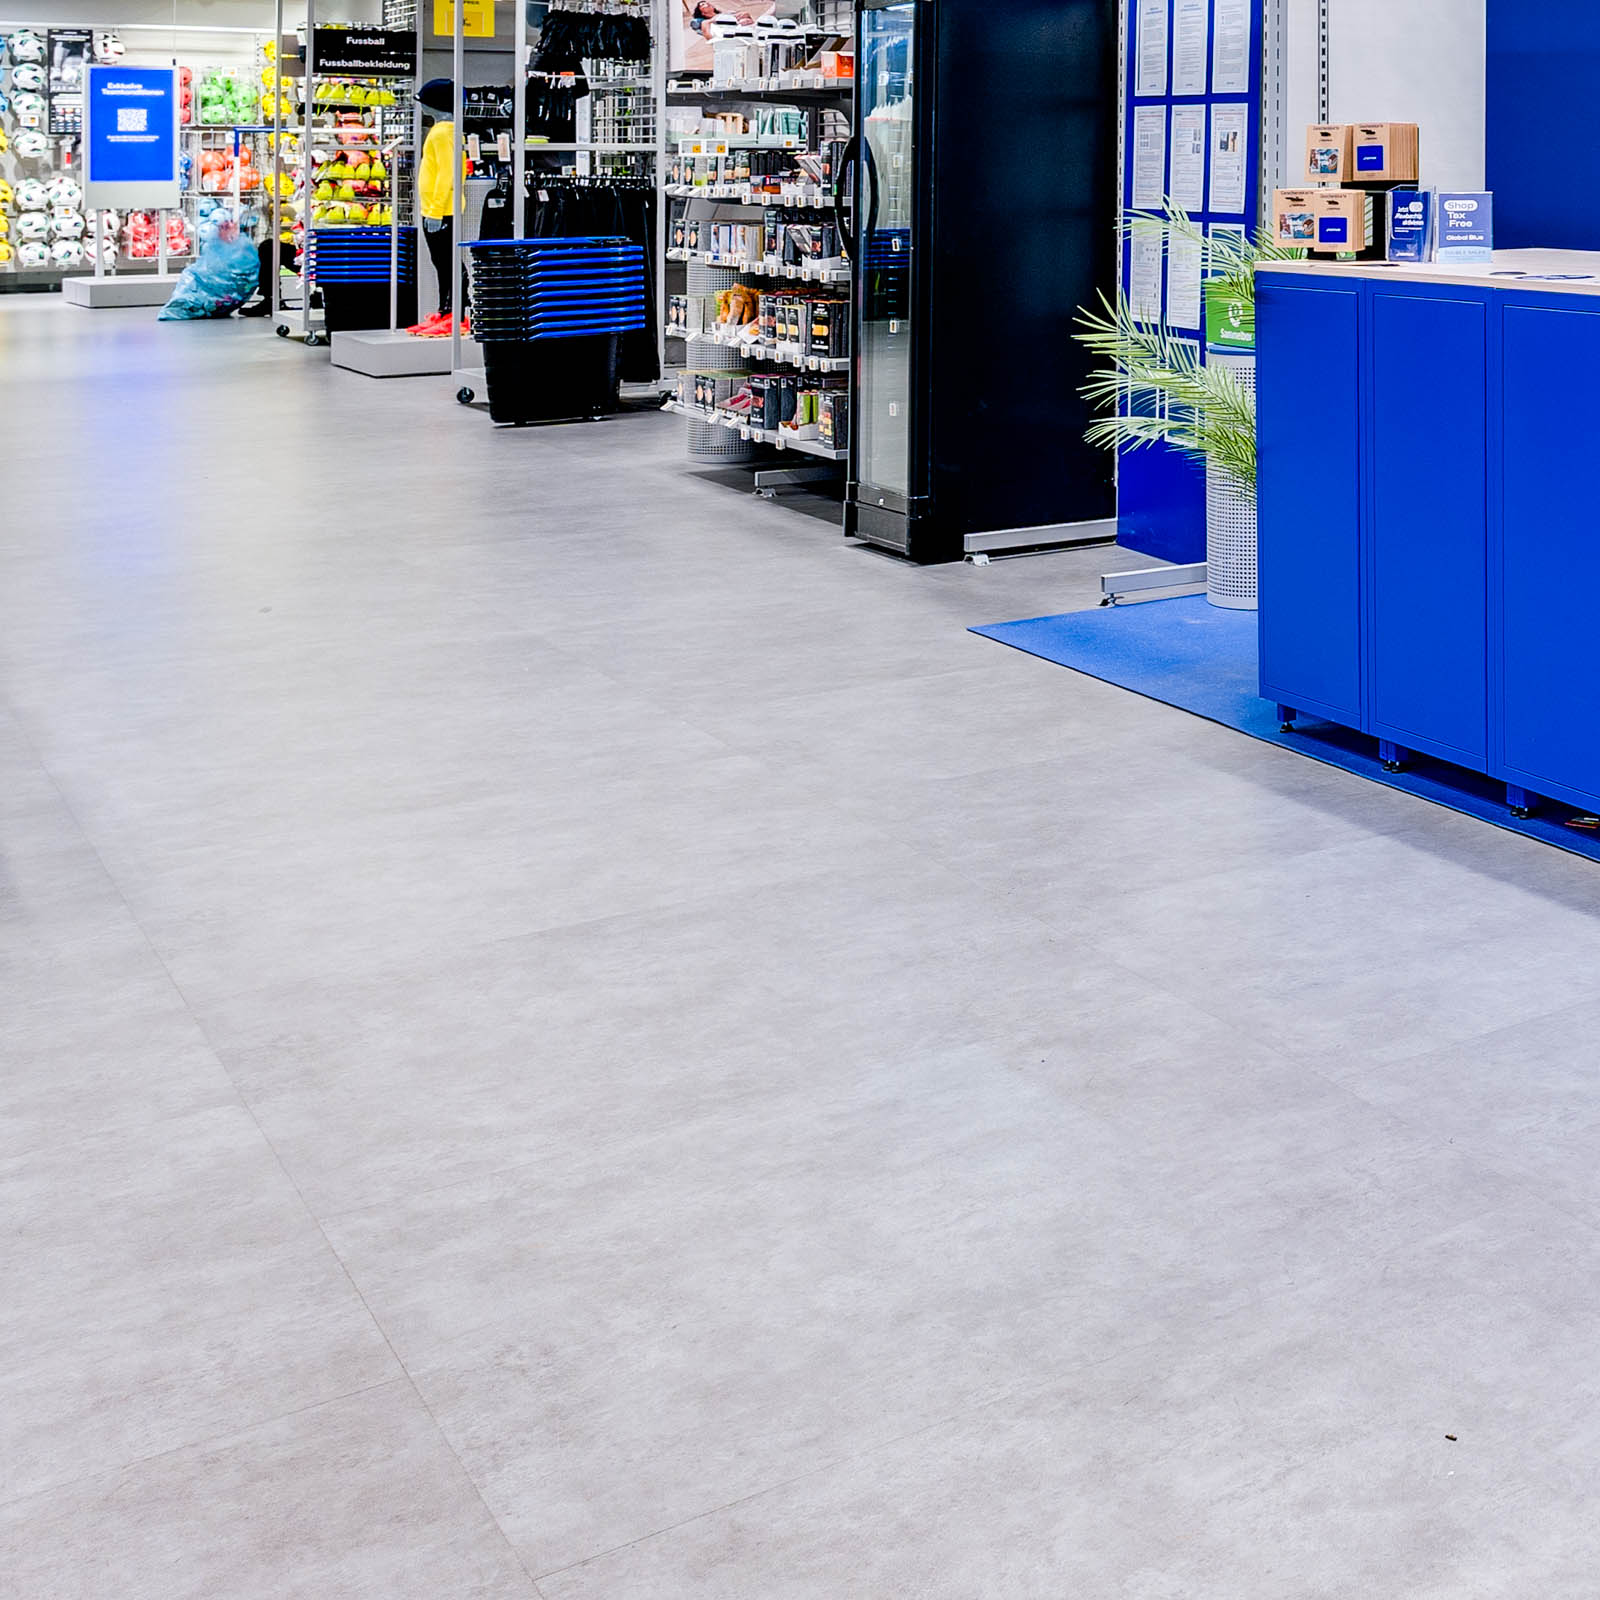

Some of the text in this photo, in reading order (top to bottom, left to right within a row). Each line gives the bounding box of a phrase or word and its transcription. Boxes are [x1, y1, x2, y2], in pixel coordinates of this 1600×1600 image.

[346, 36, 385, 45] Fussball
[319, 58, 410, 70] Fussballbekleidung
[1447, 202, 1474, 211] Shop
